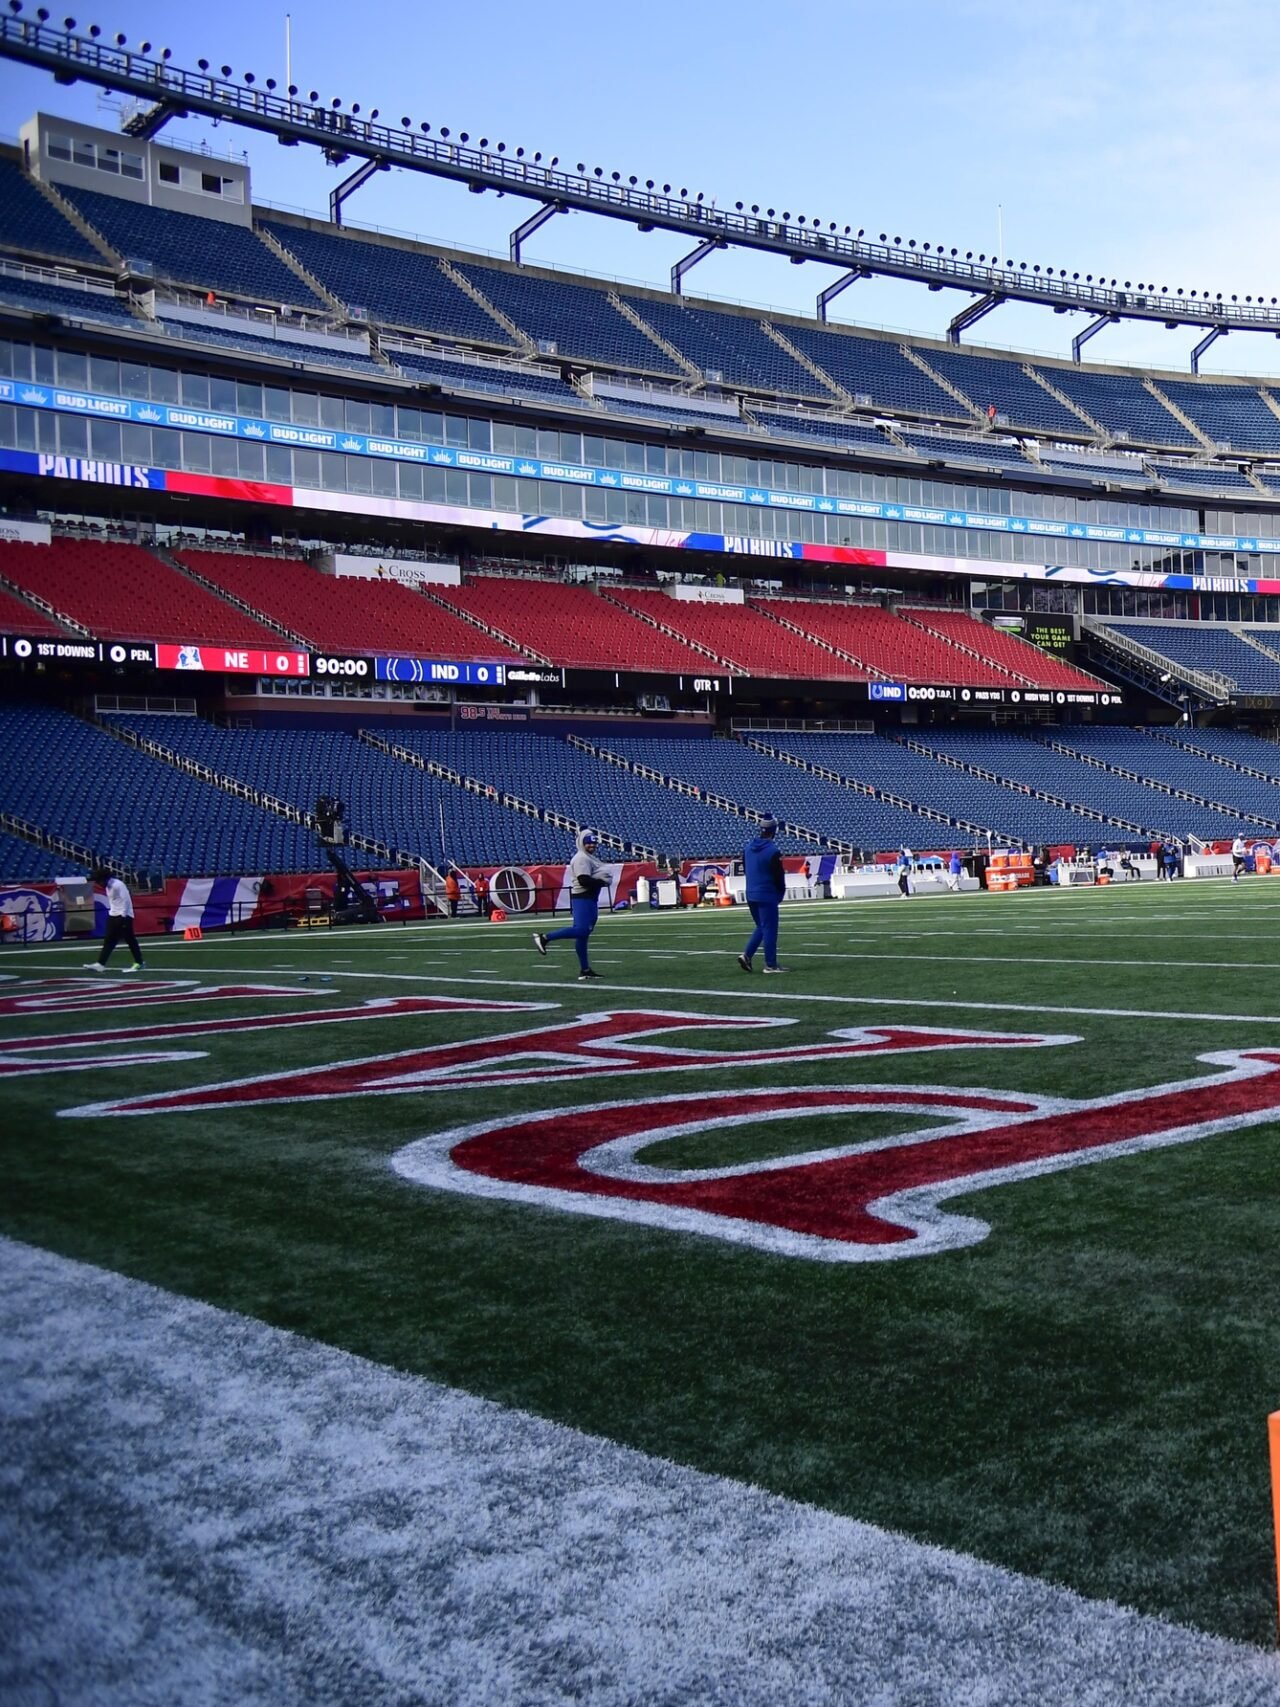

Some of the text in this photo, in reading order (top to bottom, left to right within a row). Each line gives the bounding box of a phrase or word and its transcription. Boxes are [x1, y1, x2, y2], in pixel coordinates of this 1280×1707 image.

[56, 394, 128, 414] BUD LIGHT
[169, 412, 235, 431] BUD LIGHT
[369, 442, 426, 458] BUD LIGHT
[623, 476, 670, 490] BUD LIGHT
[839, 503, 880, 514] BUD LIGHT
[1050, 627, 1066, 635] BEST
[1051, 634, 1071, 642] GAME
[14, 639, 95, 658] 0 1ST DOWNS
[110, 645, 153, 663] 0 PEN.
[224, 651, 289, 671] NE 0
[316, 657, 368, 675] 90:00
[431, 664, 489, 681] IND 0
[694, 679, 719, 692] QTR 1
[883, 686, 901, 698] IND
[908, 687, 935, 700] 0:00
[962, 689, 970, 701] 0
[1011, 690, 1020, 702] 0
[1056, 692, 1065, 704] 0
[1101, 693, 1110, 705] 0
[187, 927, 201, 939] 10
